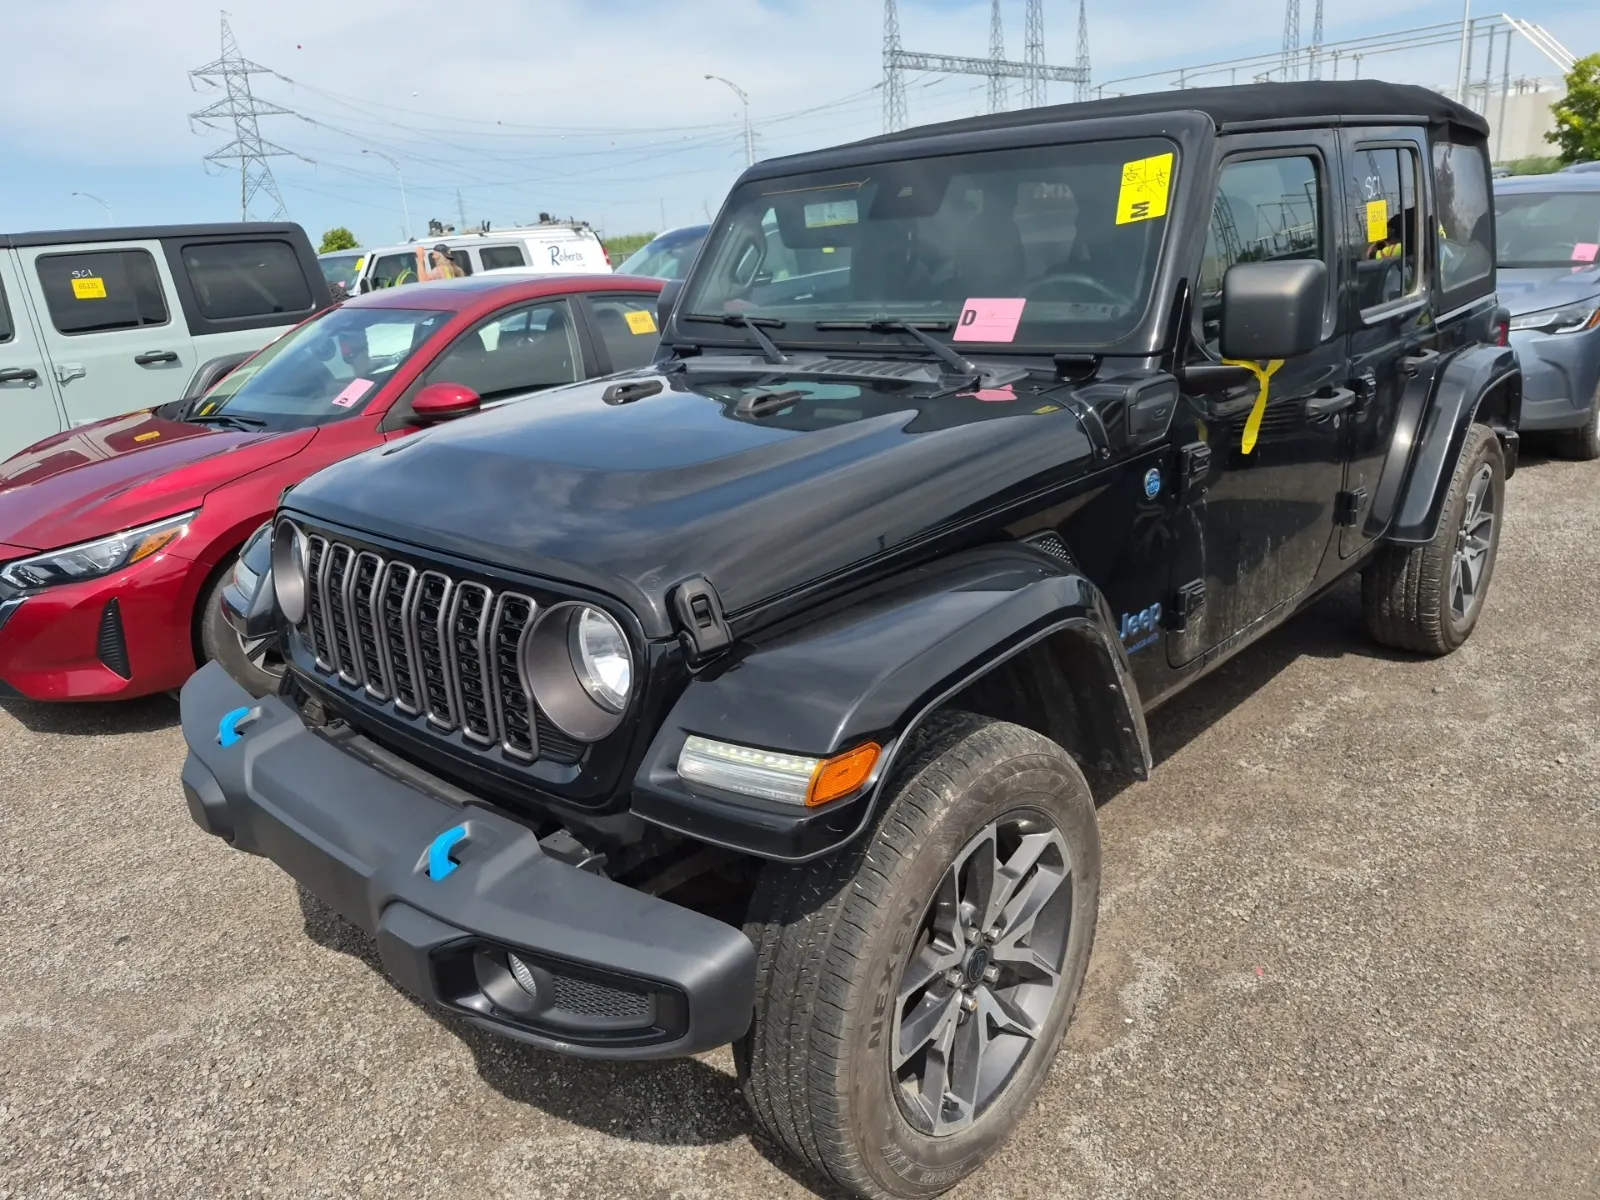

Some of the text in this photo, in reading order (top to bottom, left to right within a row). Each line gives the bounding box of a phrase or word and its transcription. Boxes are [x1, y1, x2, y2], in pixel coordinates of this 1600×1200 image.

[1130, 201, 1150, 219] M
[547, 245, 584, 266] Roberts
[960, 309, 977, 326] D
[1119, 602, 1162, 642] Jeep
[868, 898, 920, 1050] NEXEN
